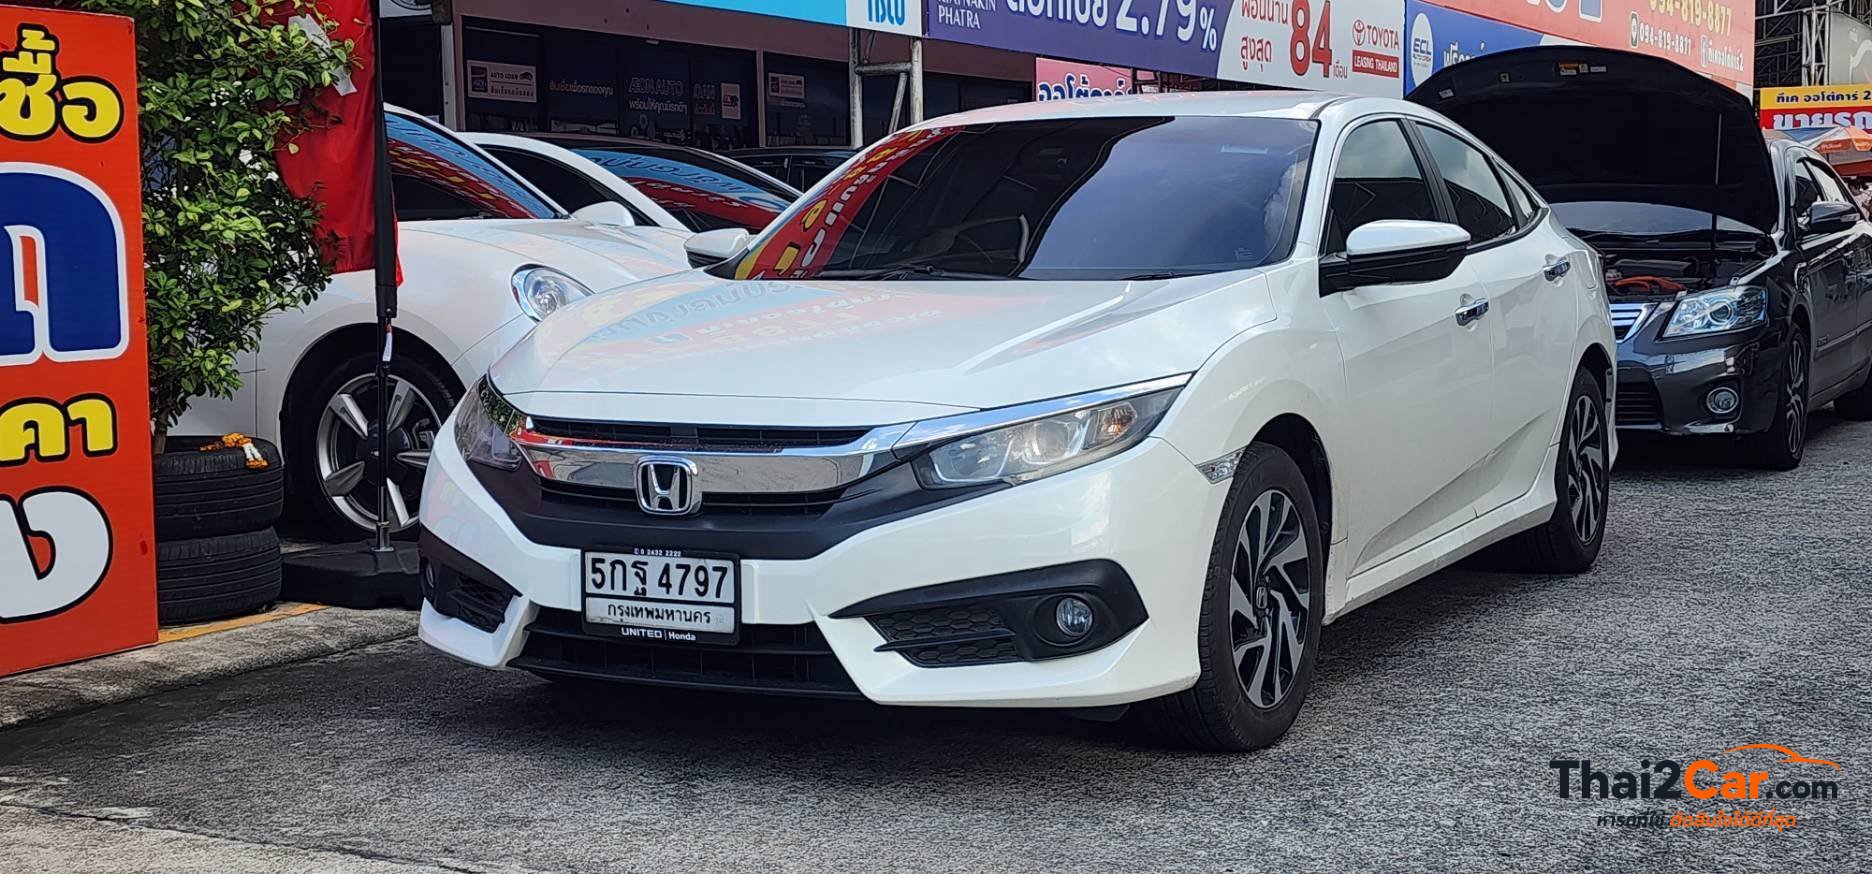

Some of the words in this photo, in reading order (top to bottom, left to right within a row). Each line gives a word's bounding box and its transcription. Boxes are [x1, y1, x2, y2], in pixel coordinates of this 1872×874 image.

[938, 5, 981, 30] PHATRA
[1290, 0, 1333, 78] 84
[1367, 25, 1400, 50] TOYOTA
[1413, 37, 1432, 55] ECL
[1240, 36, 1272, 72] สูงสุด
[1354, 55, 1375, 70] LEASING
[1375, 58, 1398, 73] THAILAND
[654, 79, 684, 96] AUTO
[1863, 90, 1872, 101] 2
[591, 557, 648, 597] 5กฐ
[658, 563, 728, 599] 4797
[607, 603, 711, 624] กรุงเทพมหานคร
[621, 626, 663, 639] UNITED
[668, 631, 696, 641] Honda
